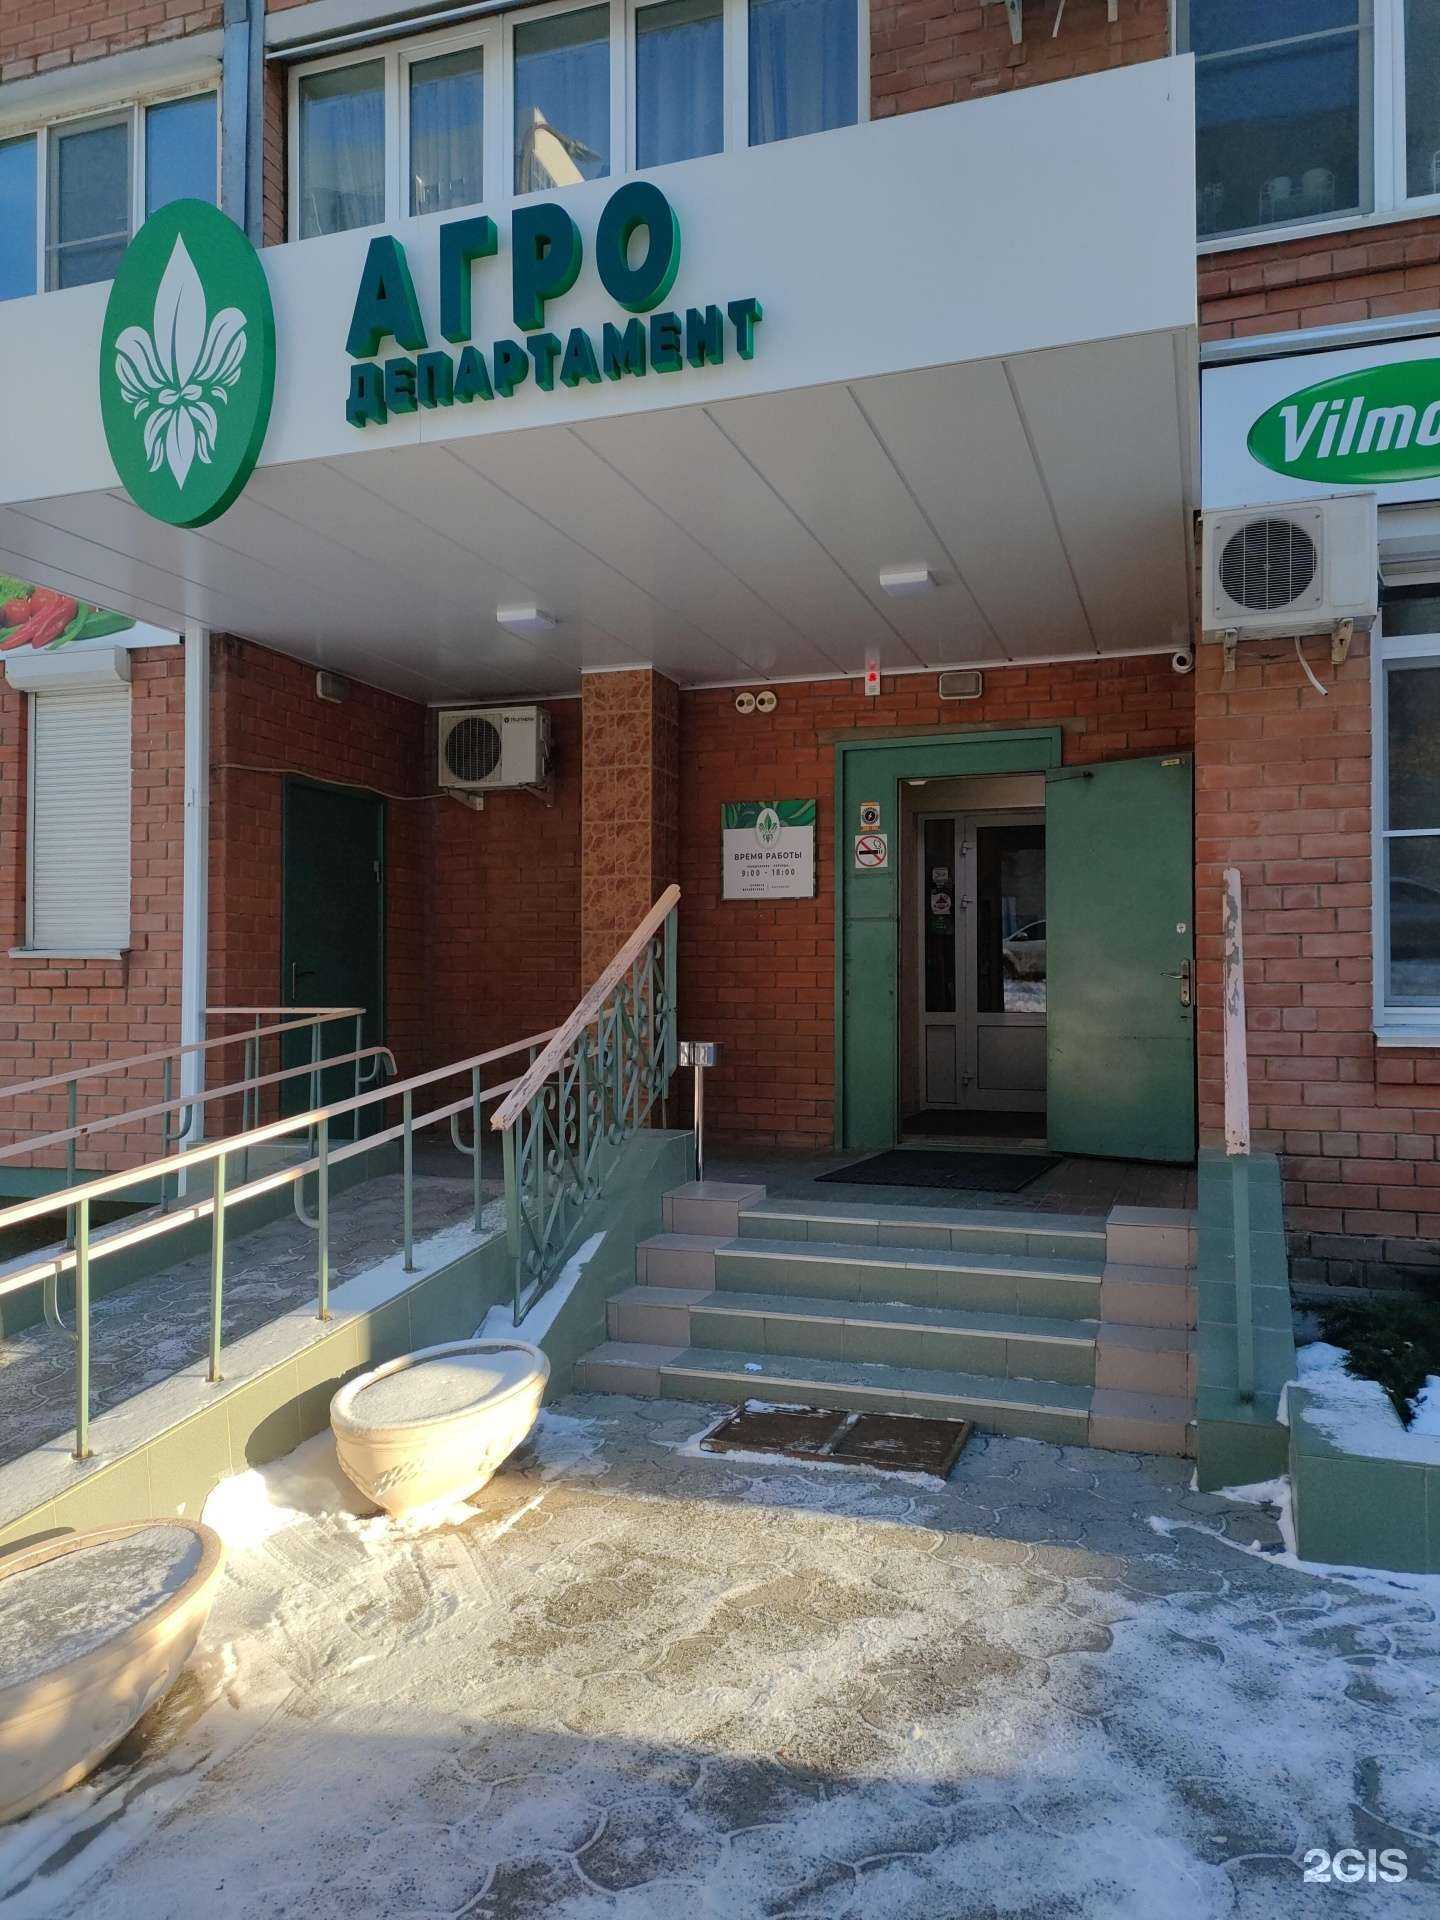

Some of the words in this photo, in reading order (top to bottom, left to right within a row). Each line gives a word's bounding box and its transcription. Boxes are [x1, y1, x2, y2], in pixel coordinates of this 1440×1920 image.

[346, 181, 681, 358] АГРО
[346, 297, 763, 428] ДЕПАРТАМЕНТ
[734, 852, 763, 861] ВРЕМЯ
[766, 851, 802, 860] РАБОТЫ
[741, 869, 760, 877] 9:00
[772, 868, 795, 876] 18:00
